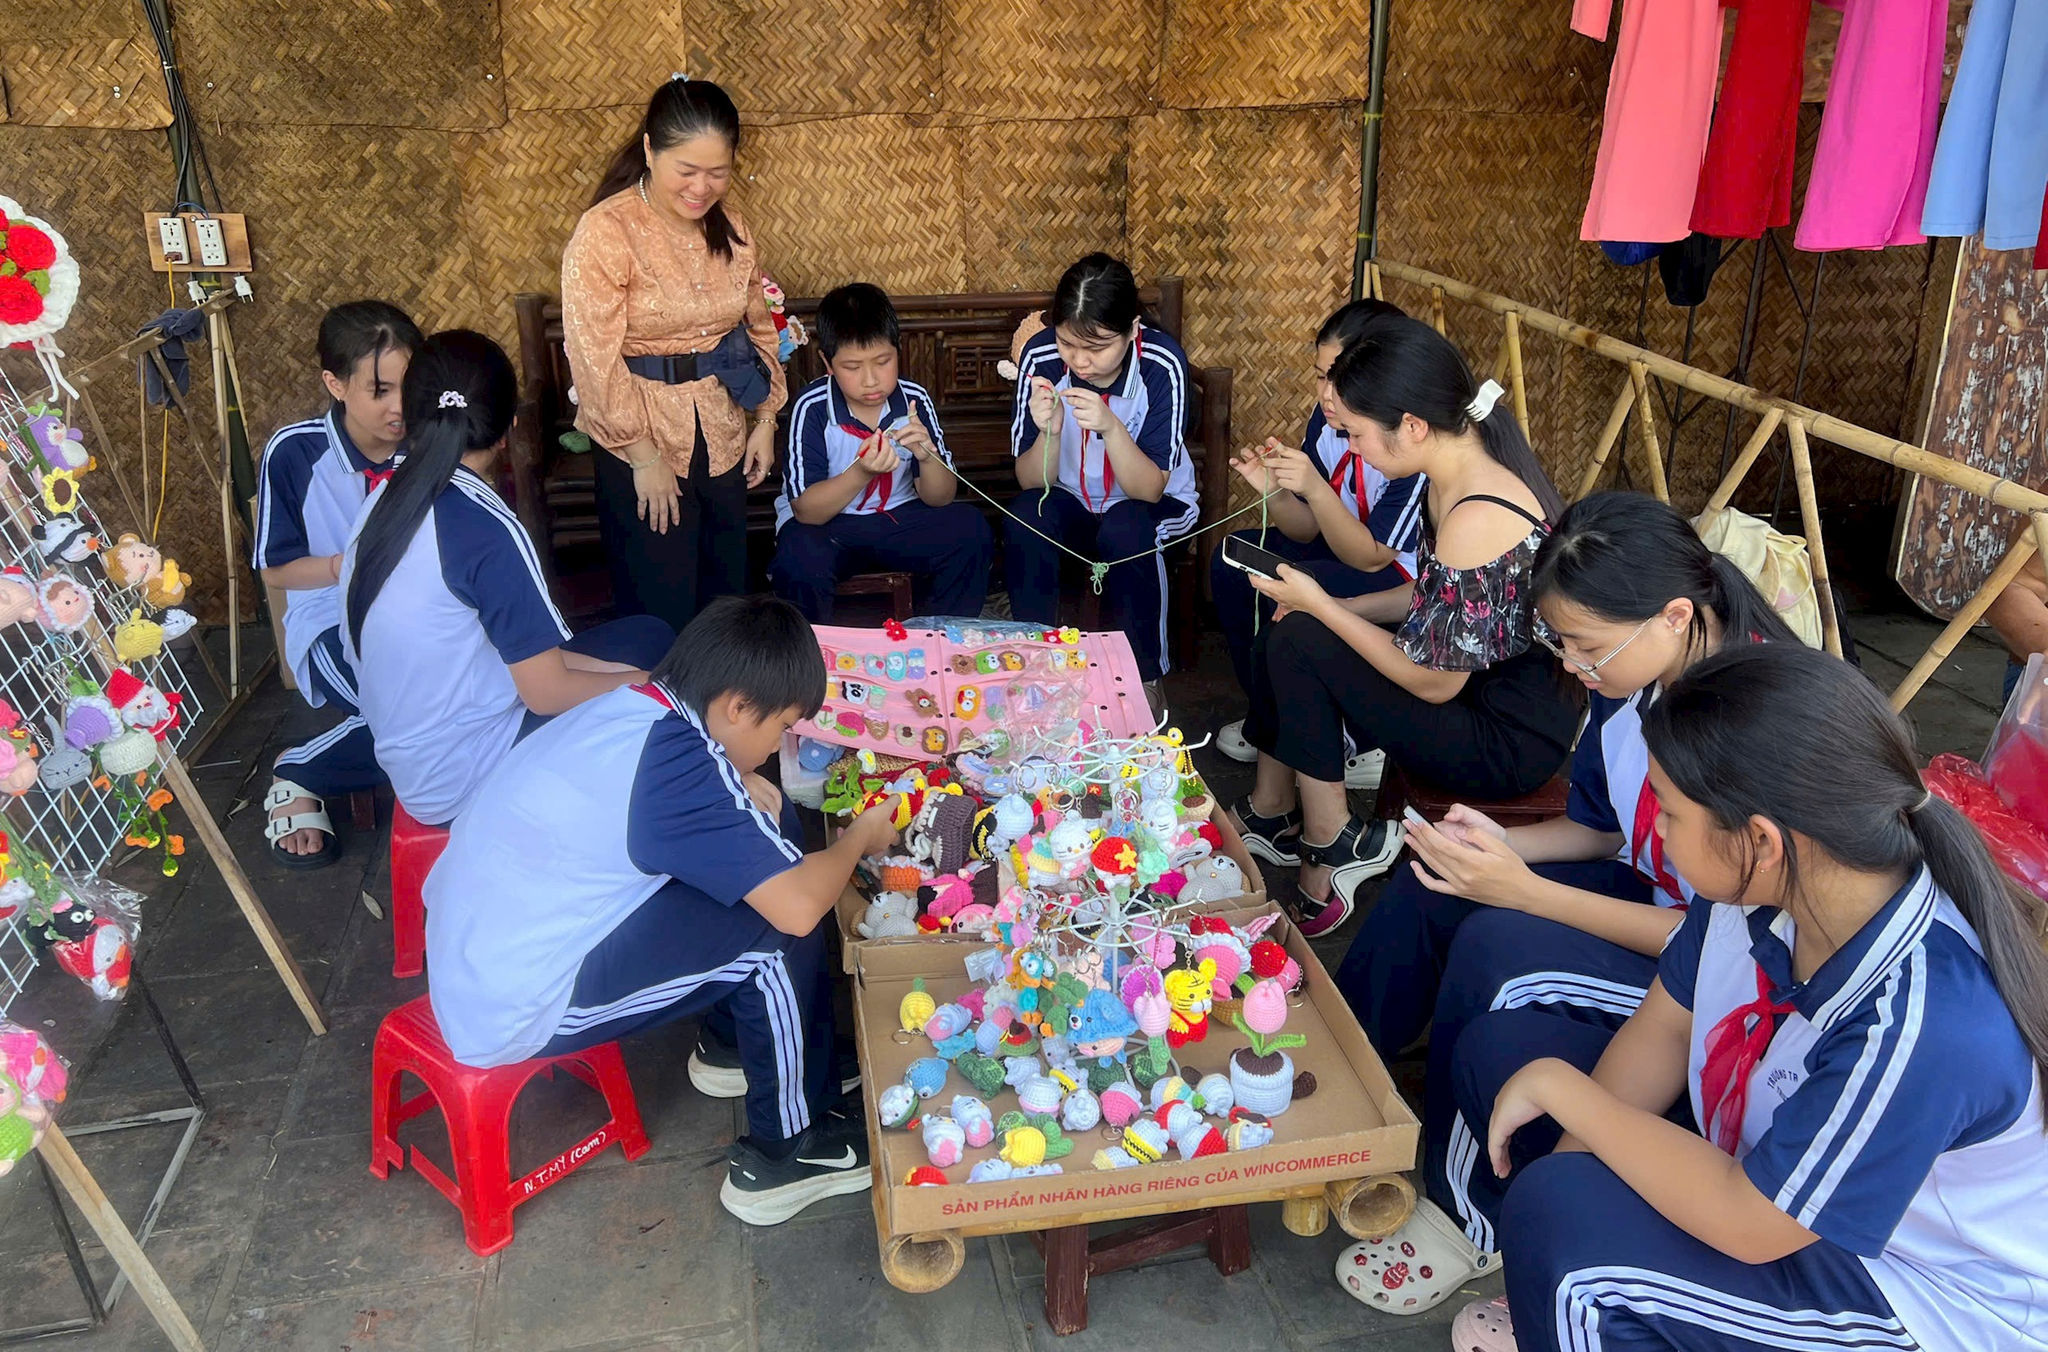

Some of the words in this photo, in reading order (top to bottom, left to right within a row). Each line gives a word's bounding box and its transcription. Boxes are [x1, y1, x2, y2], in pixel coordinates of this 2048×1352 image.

[942, 1198, 979, 1215] SẢN
[983, 1190, 1034, 1211] PHẨM
[1039, 1187, 1088, 1204] NHÃN
[1093, 1183, 1142, 1199] HÀNG
[1147, 1175, 1200, 1192] RIÊNG
[1204, 1167, 1239, 1184] CỦA
[1243, 1150, 1371, 1178] WINCOMMERCE
